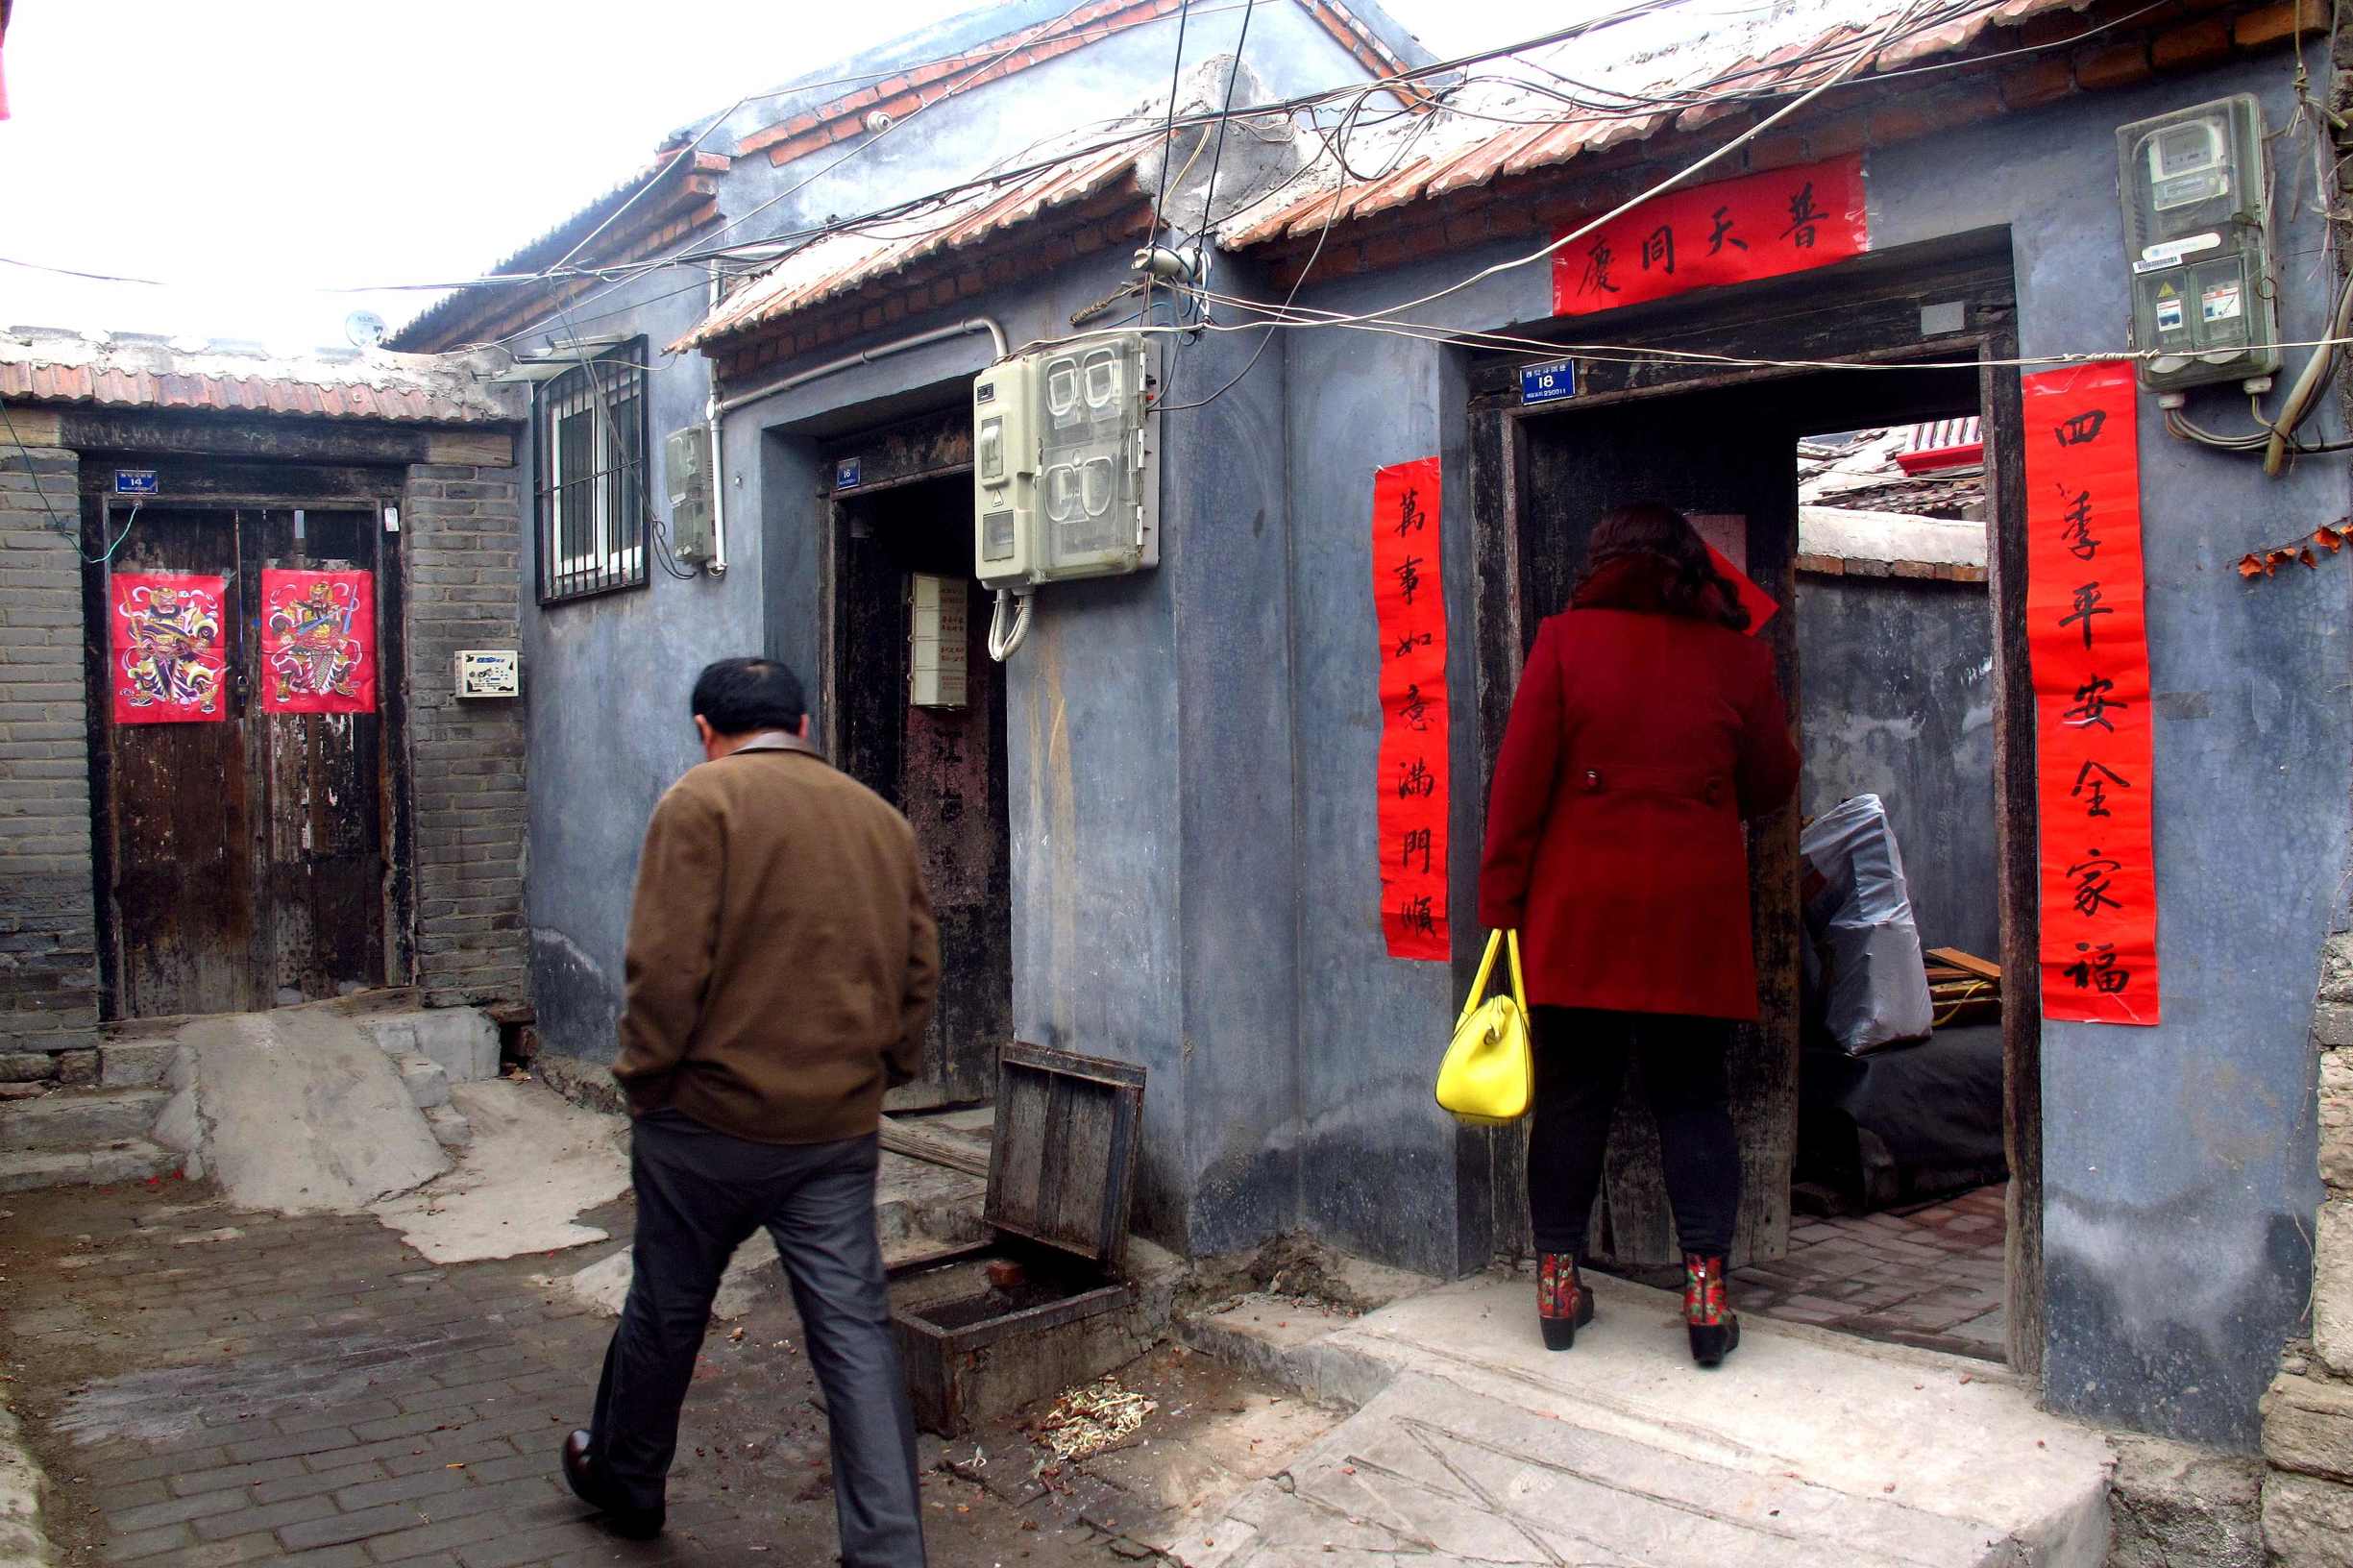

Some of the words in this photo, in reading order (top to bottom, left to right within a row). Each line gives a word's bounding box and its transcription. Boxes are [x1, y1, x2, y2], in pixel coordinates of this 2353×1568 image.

[1538, 374, 1555, 389] 18
[2054, 407, 2131, 994] 四季平安全家福
